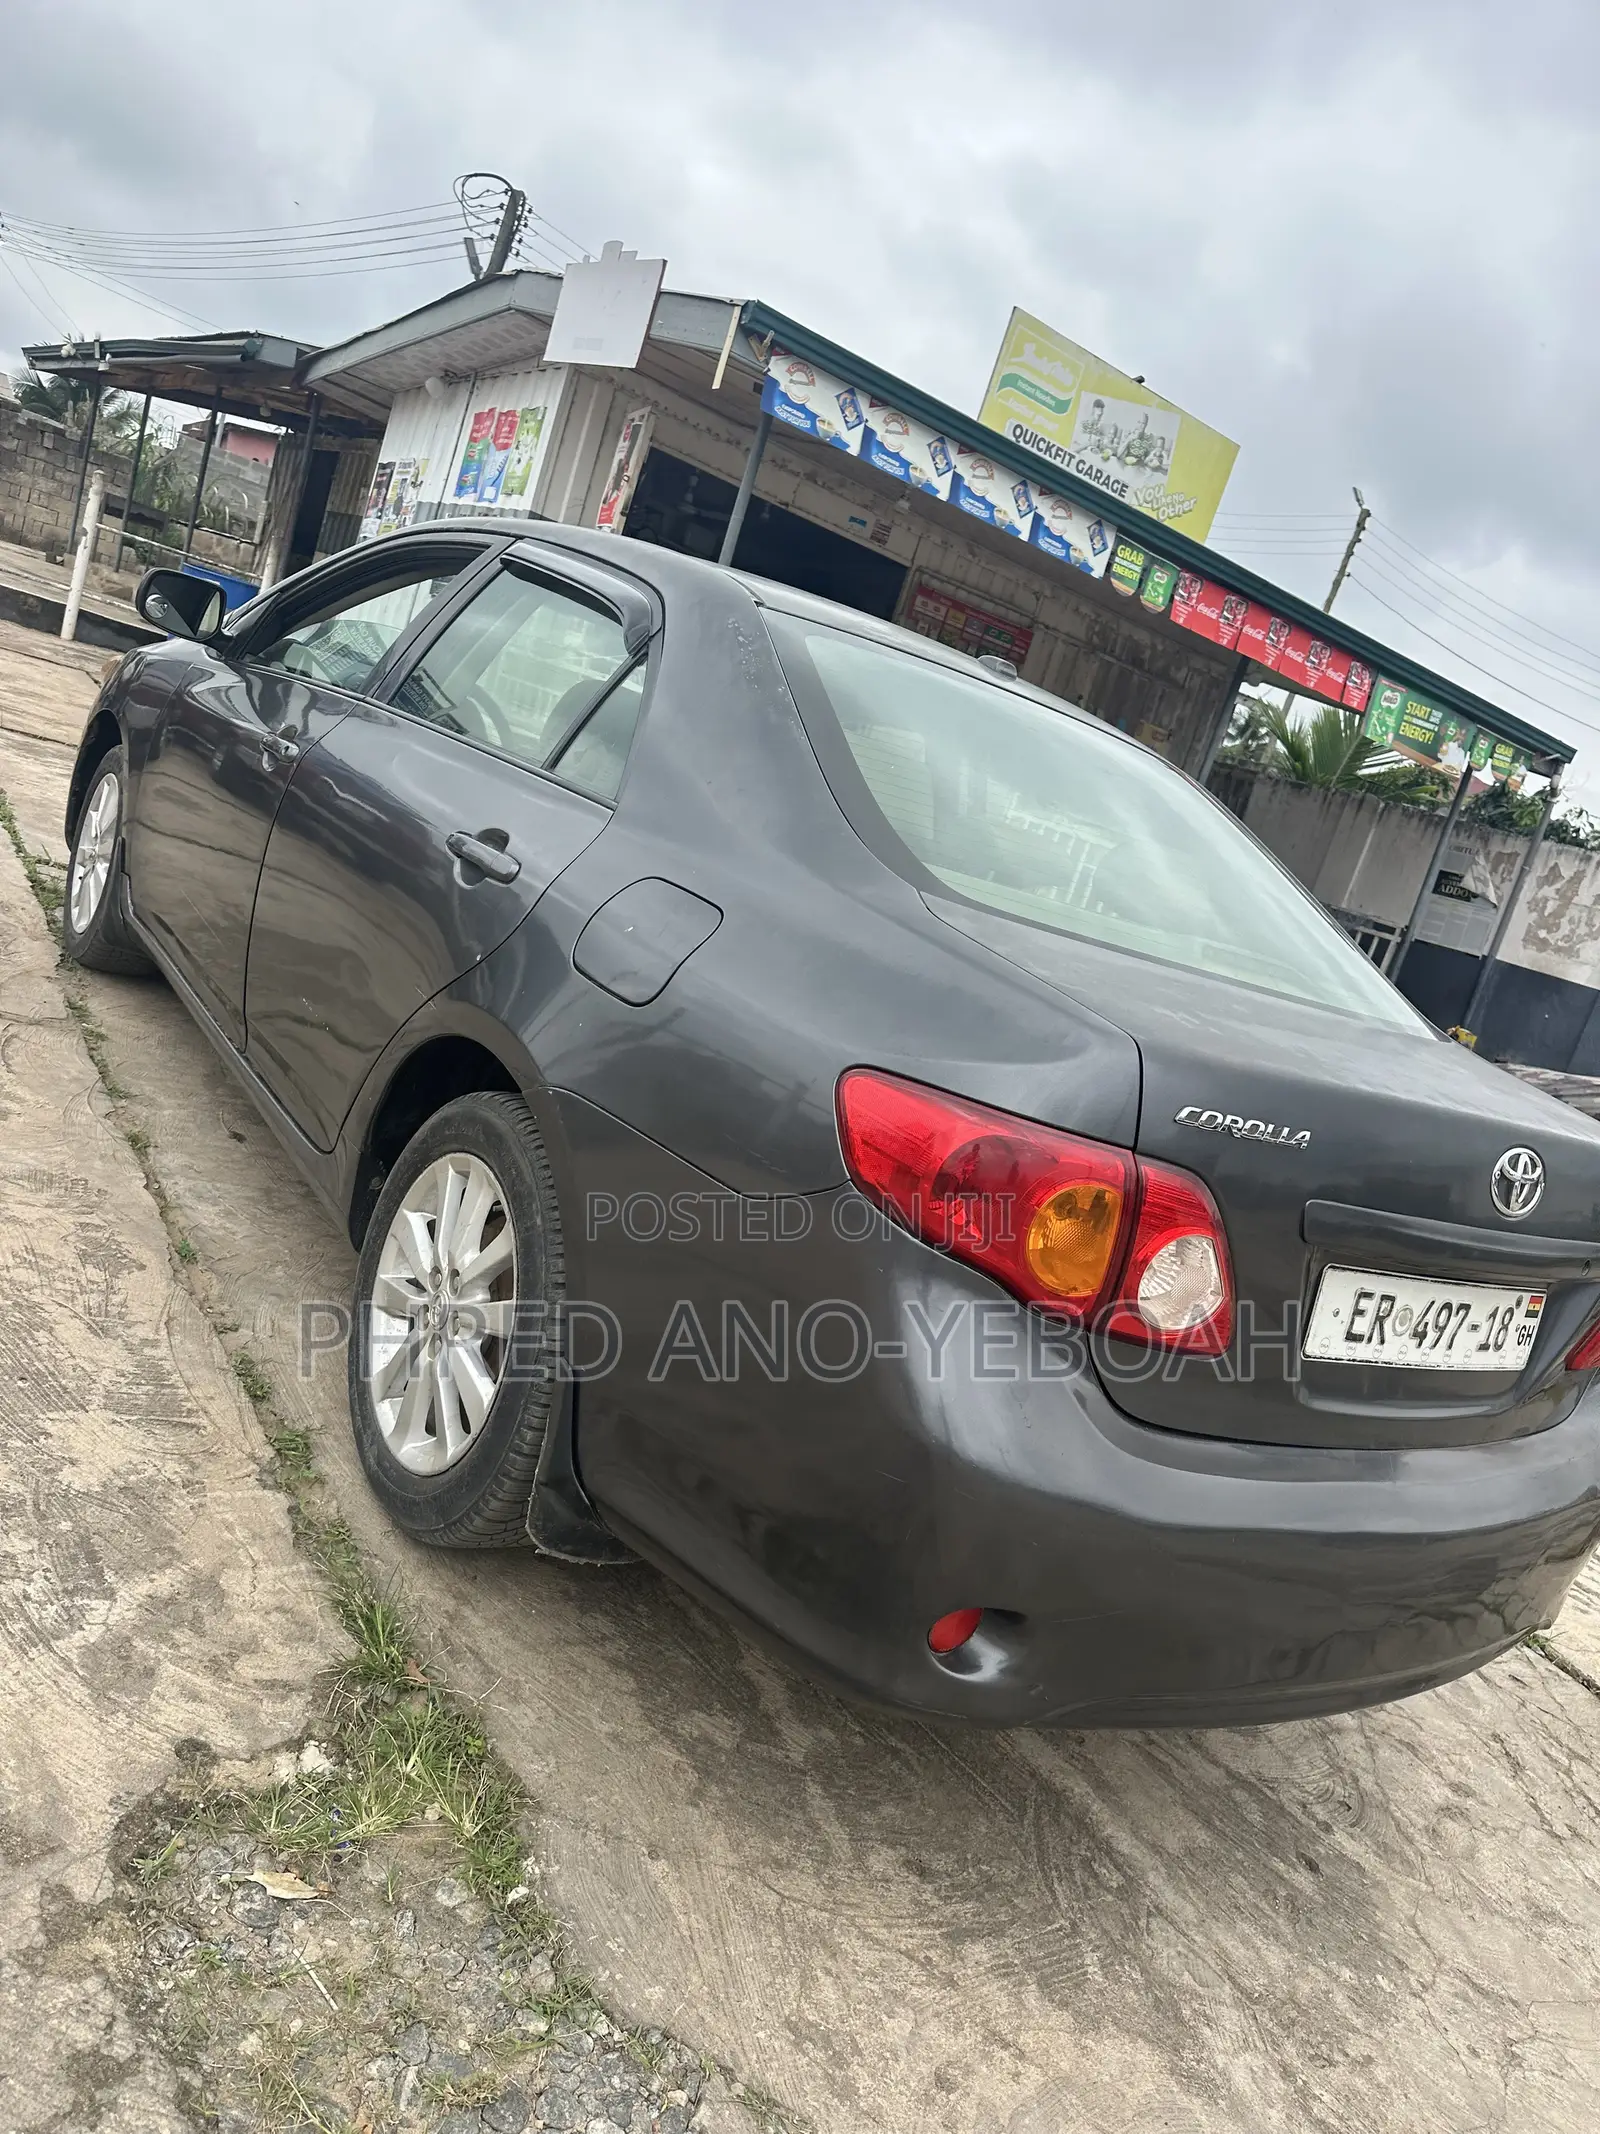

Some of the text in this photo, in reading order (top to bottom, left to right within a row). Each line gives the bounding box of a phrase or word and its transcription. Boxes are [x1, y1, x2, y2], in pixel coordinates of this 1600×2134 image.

[1012, 423, 1129, 499] QUICKFIT GARAGE
[1117, 544, 1145, 566] GRAB
[1405, 701, 1431, 720] START
[1398, 721, 1436, 745] ENERGY!
[1439, 883, 1469, 898] ADDO
[1175, 1105, 1312, 1150] COROLLA
[1344, 1287, 1516, 1353] ER 497-18
[1517, 1323, 1534, 1347] GH
